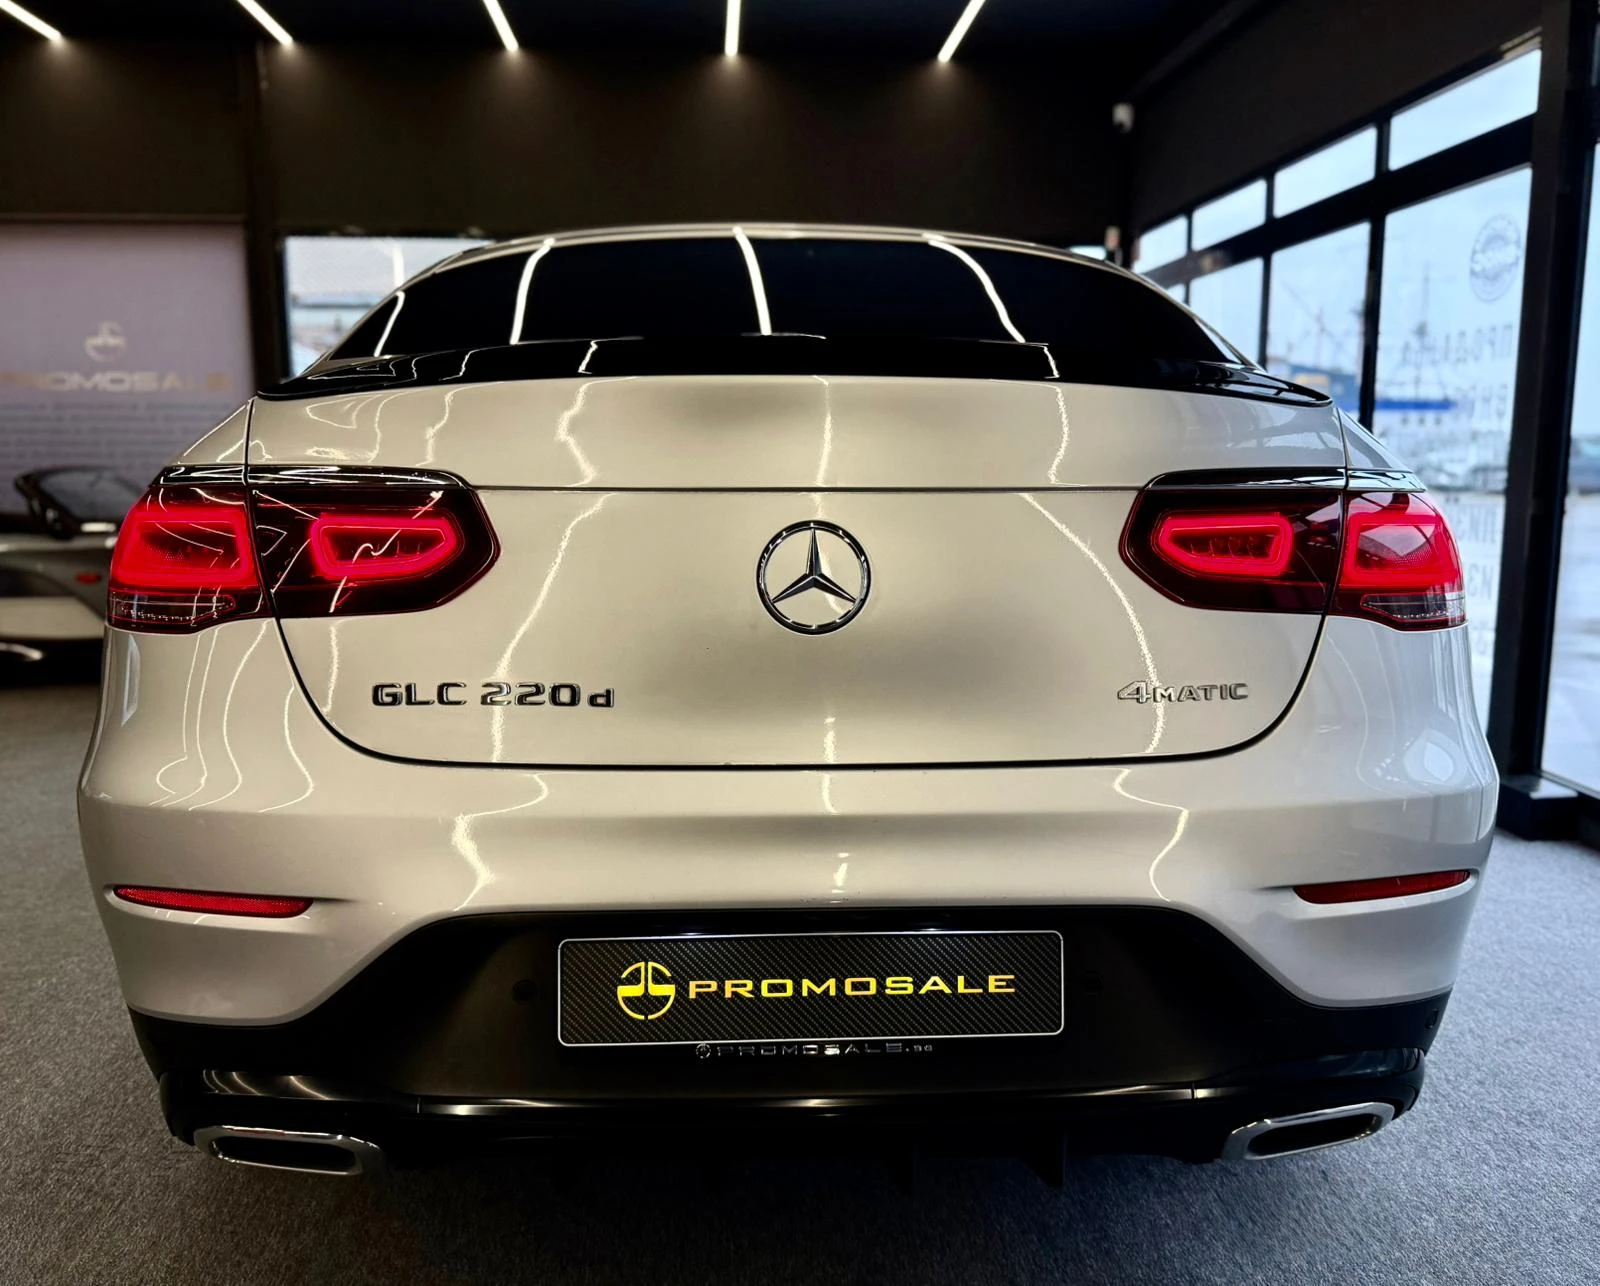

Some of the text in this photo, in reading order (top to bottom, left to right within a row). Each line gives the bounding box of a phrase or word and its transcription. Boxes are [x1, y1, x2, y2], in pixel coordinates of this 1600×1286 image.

[0, 371, 233, 393] OMOSAL
[372, 682, 616, 708] GLC 220d
[1117, 680, 1249, 704] 4MATIC
[688, 974, 1017, 1000] PROMOSALE
